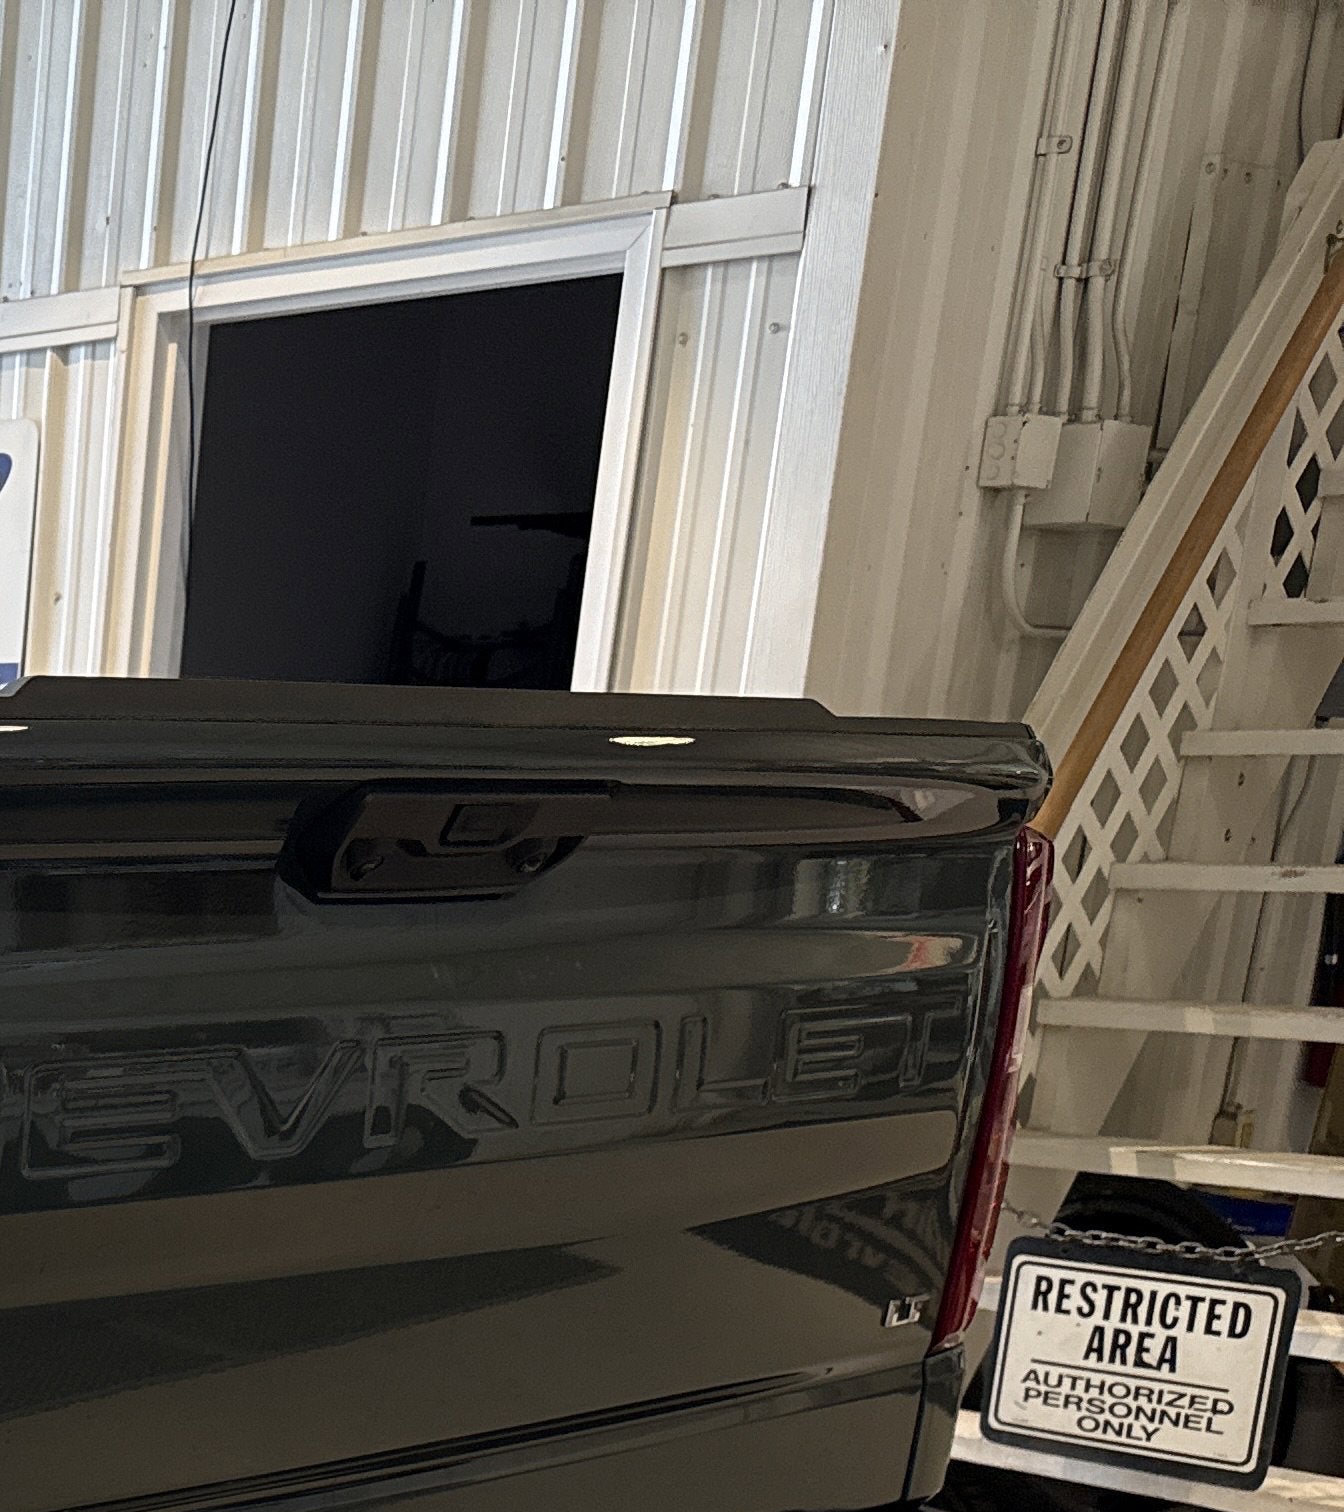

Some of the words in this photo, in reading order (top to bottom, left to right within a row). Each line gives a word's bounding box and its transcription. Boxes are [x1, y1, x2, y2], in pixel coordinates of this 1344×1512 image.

[1031, 1275, 1253, 1340] RESTRICTED
[1083, 1325, 1179, 1373] AREA
[1020, 1368, 1234, 1416] AUTHORIZED
[1023, 1387, 1224, 1435] PERSONNEL
[1076, 1415, 1161, 1443] ONLY
